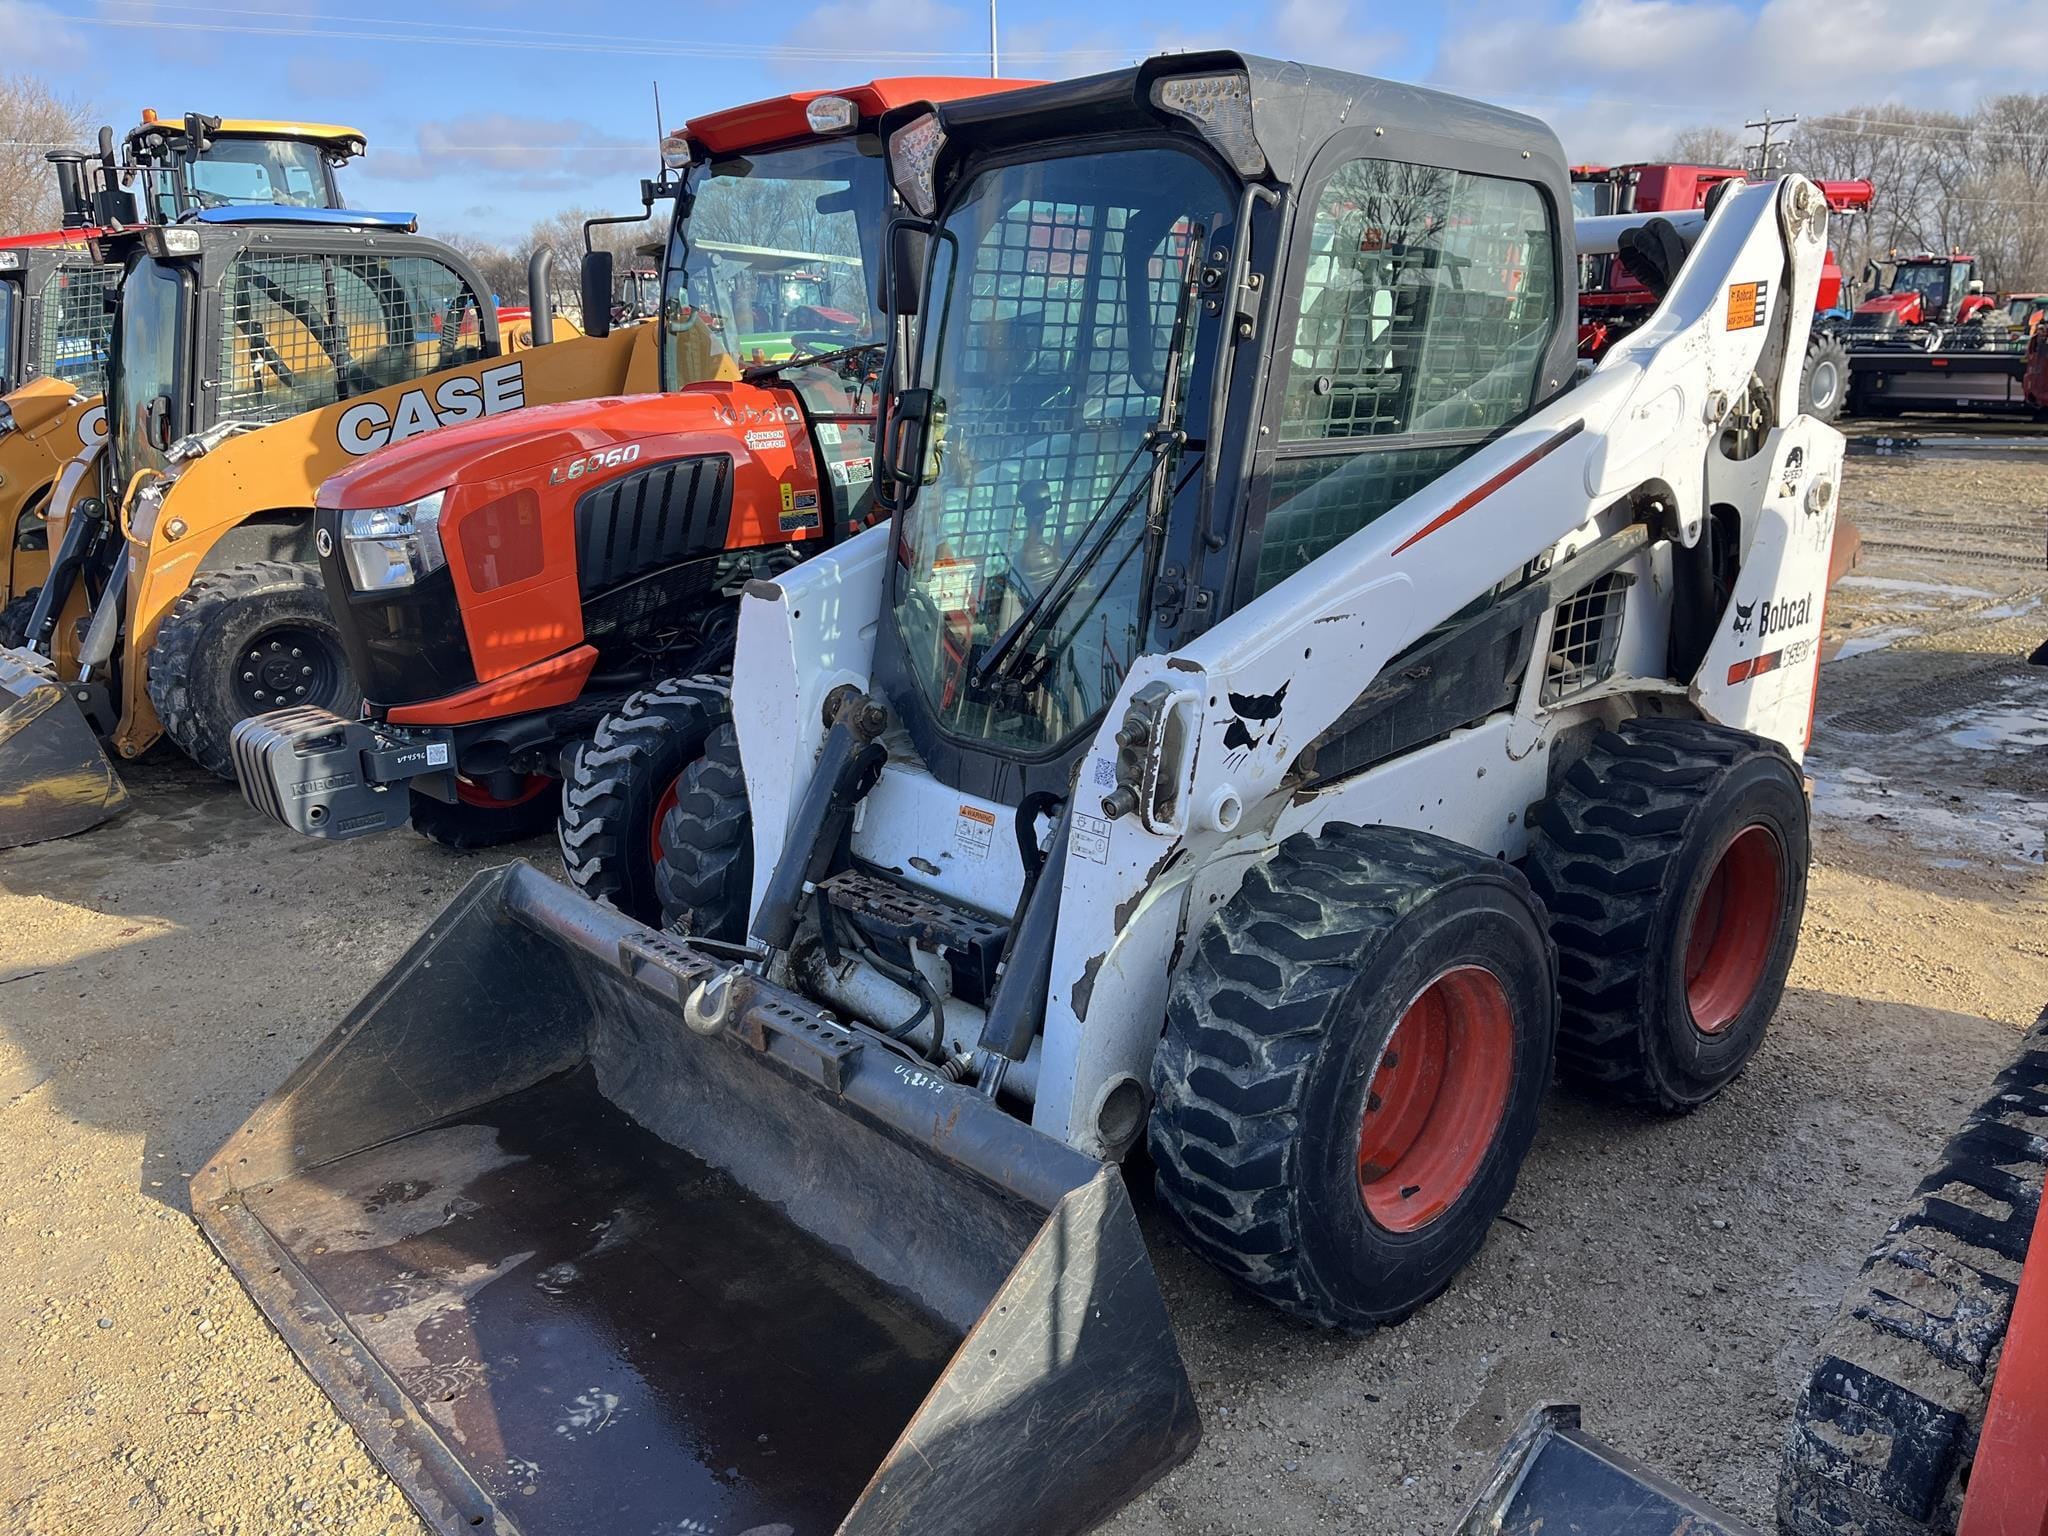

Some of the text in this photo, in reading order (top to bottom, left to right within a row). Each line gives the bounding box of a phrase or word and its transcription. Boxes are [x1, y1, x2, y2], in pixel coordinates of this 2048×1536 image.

[336, 360, 526, 455] CASE
[711, 402, 800, 427] Kubota
[745, 430, 784, 440] JOHNSON
[748, 440, 786, 449] TRACTOR
[549, 444, 641, 487] L6060
[1758, 591, 1812, 638] Bobcat
[291, 773, 355, 797] KUBOTA
[966, 808, 993, 823] WARNING
